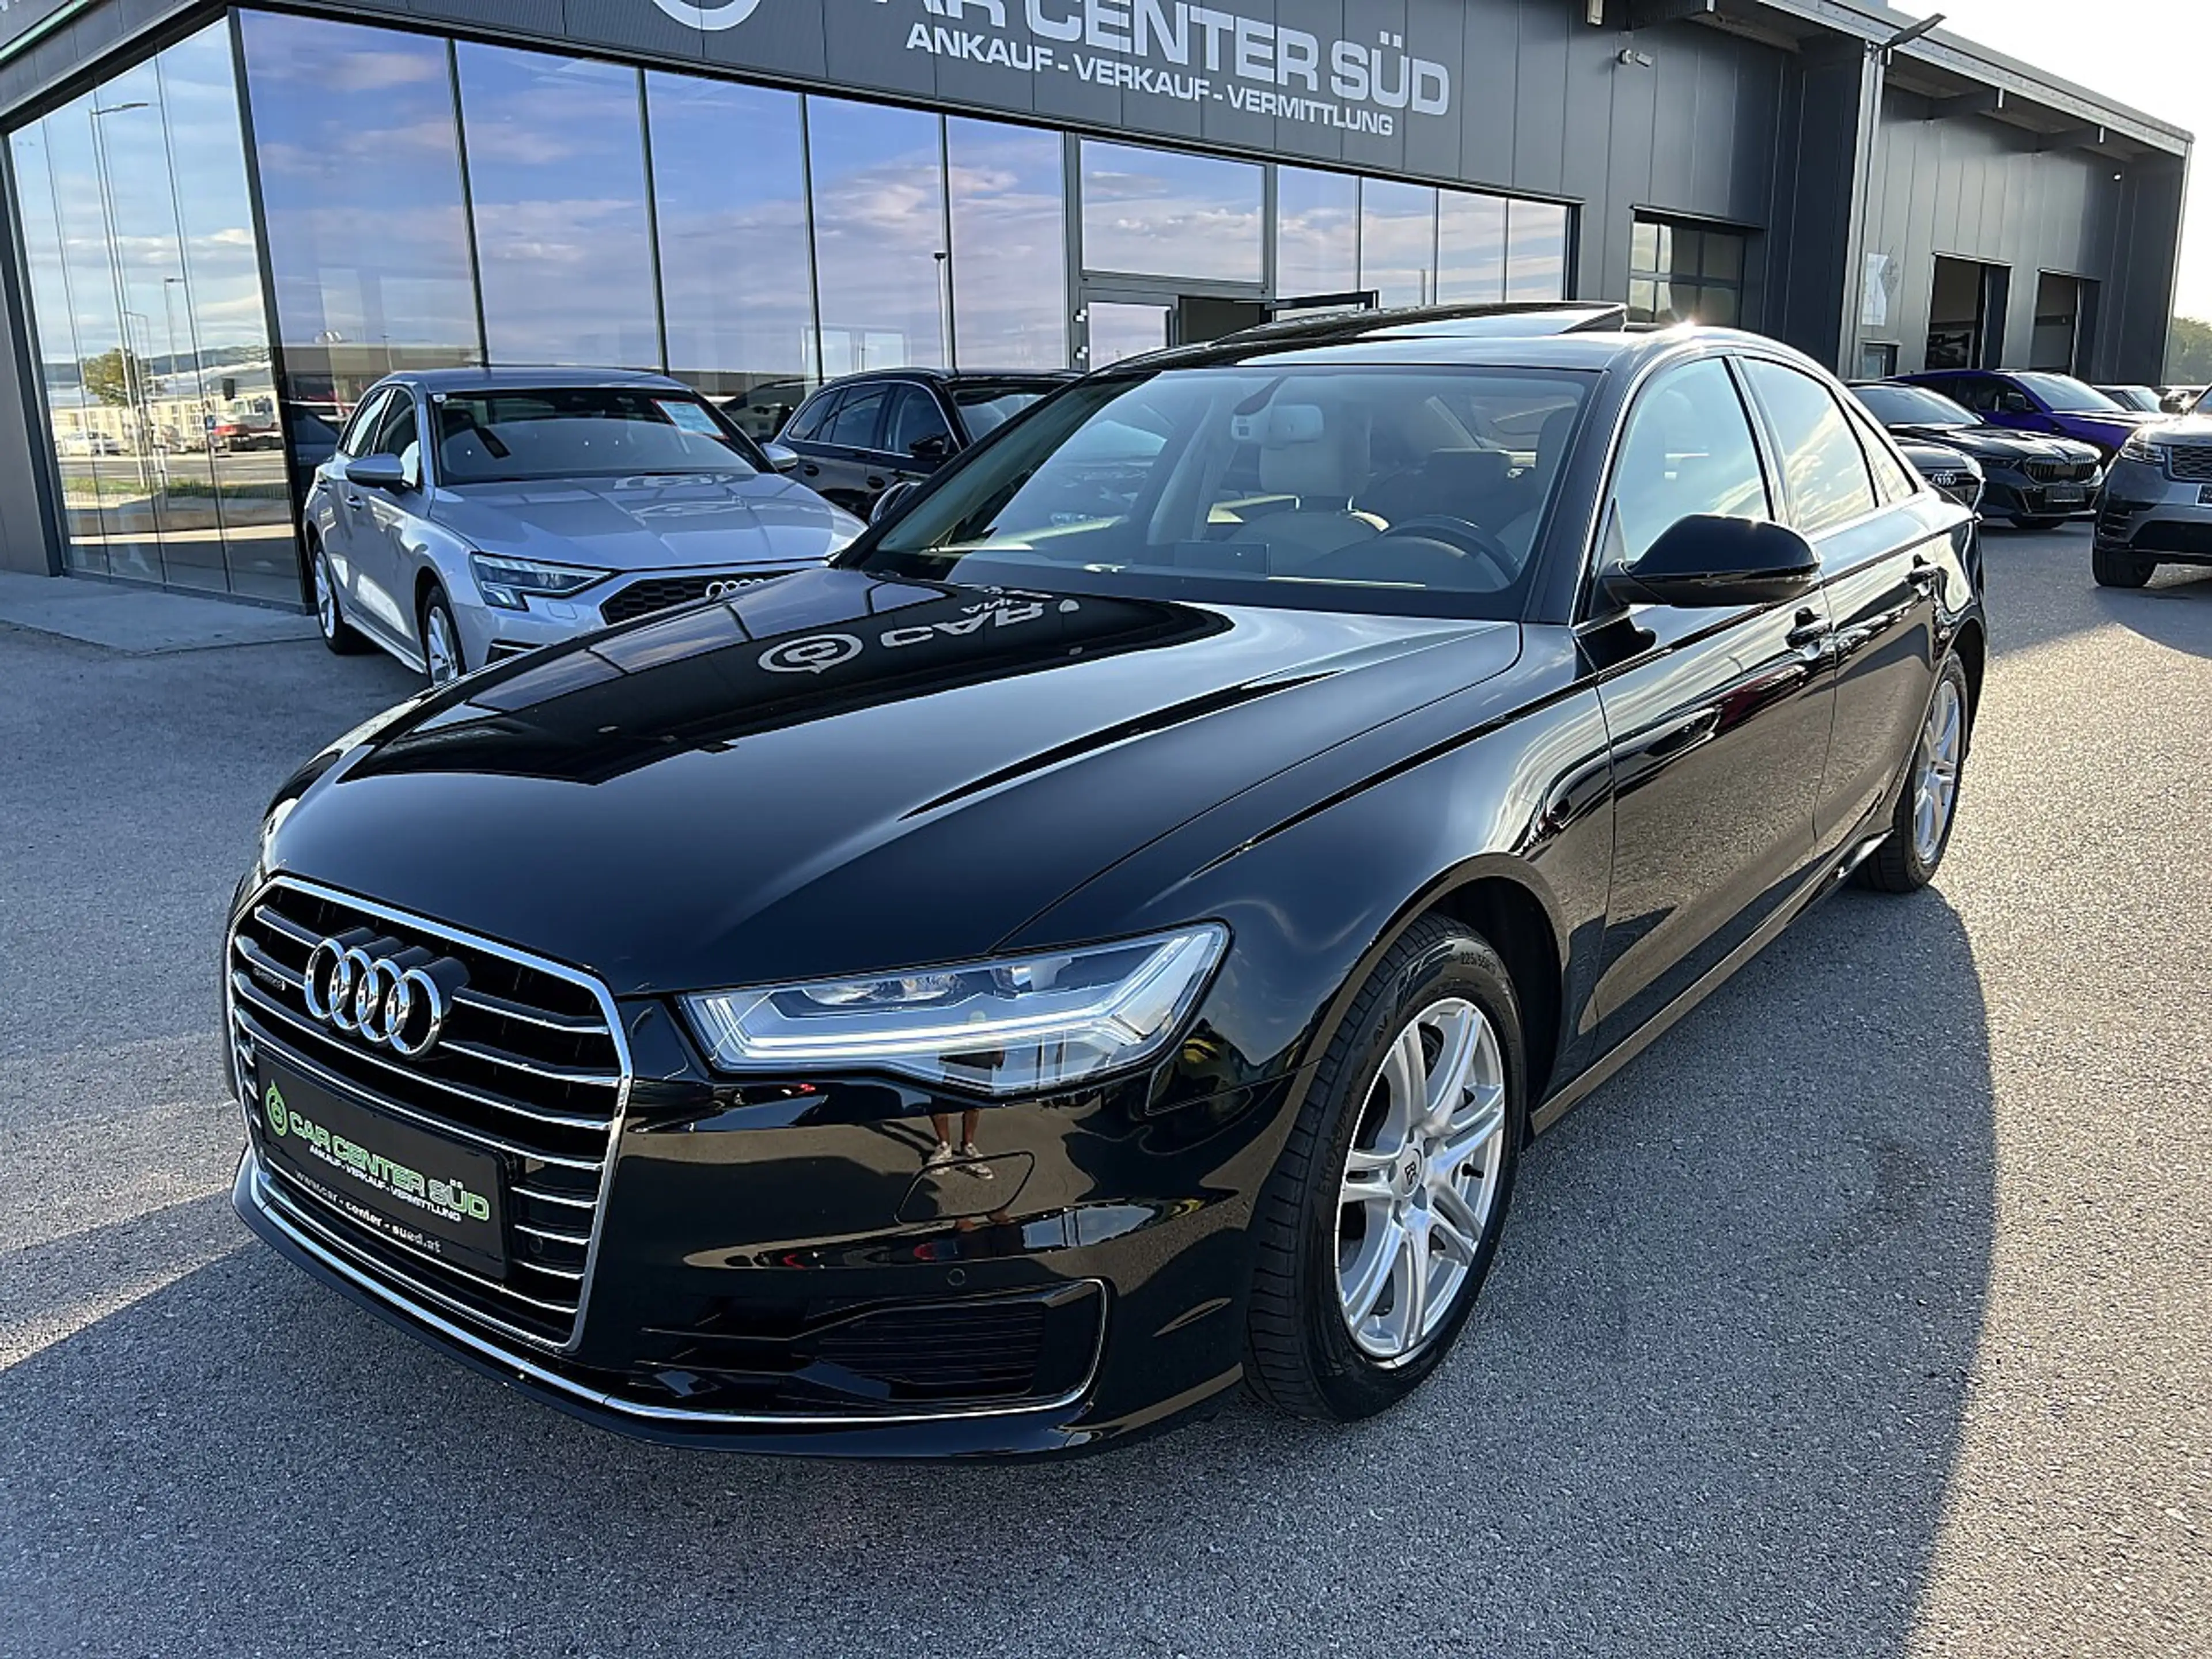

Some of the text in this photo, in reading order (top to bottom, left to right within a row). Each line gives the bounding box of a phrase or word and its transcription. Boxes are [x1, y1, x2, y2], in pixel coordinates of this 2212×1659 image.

[906, 23, 1053, 71] ANKAUF
[1073, 54, 1210, 103] VERKAUF
[1227, 85, 1393, 136] VERMITTLUNG
[1027, 0, 1450, 115] CENTER SÜD
[290, 1112, 489, 1221] CAR CENTER SÜD
